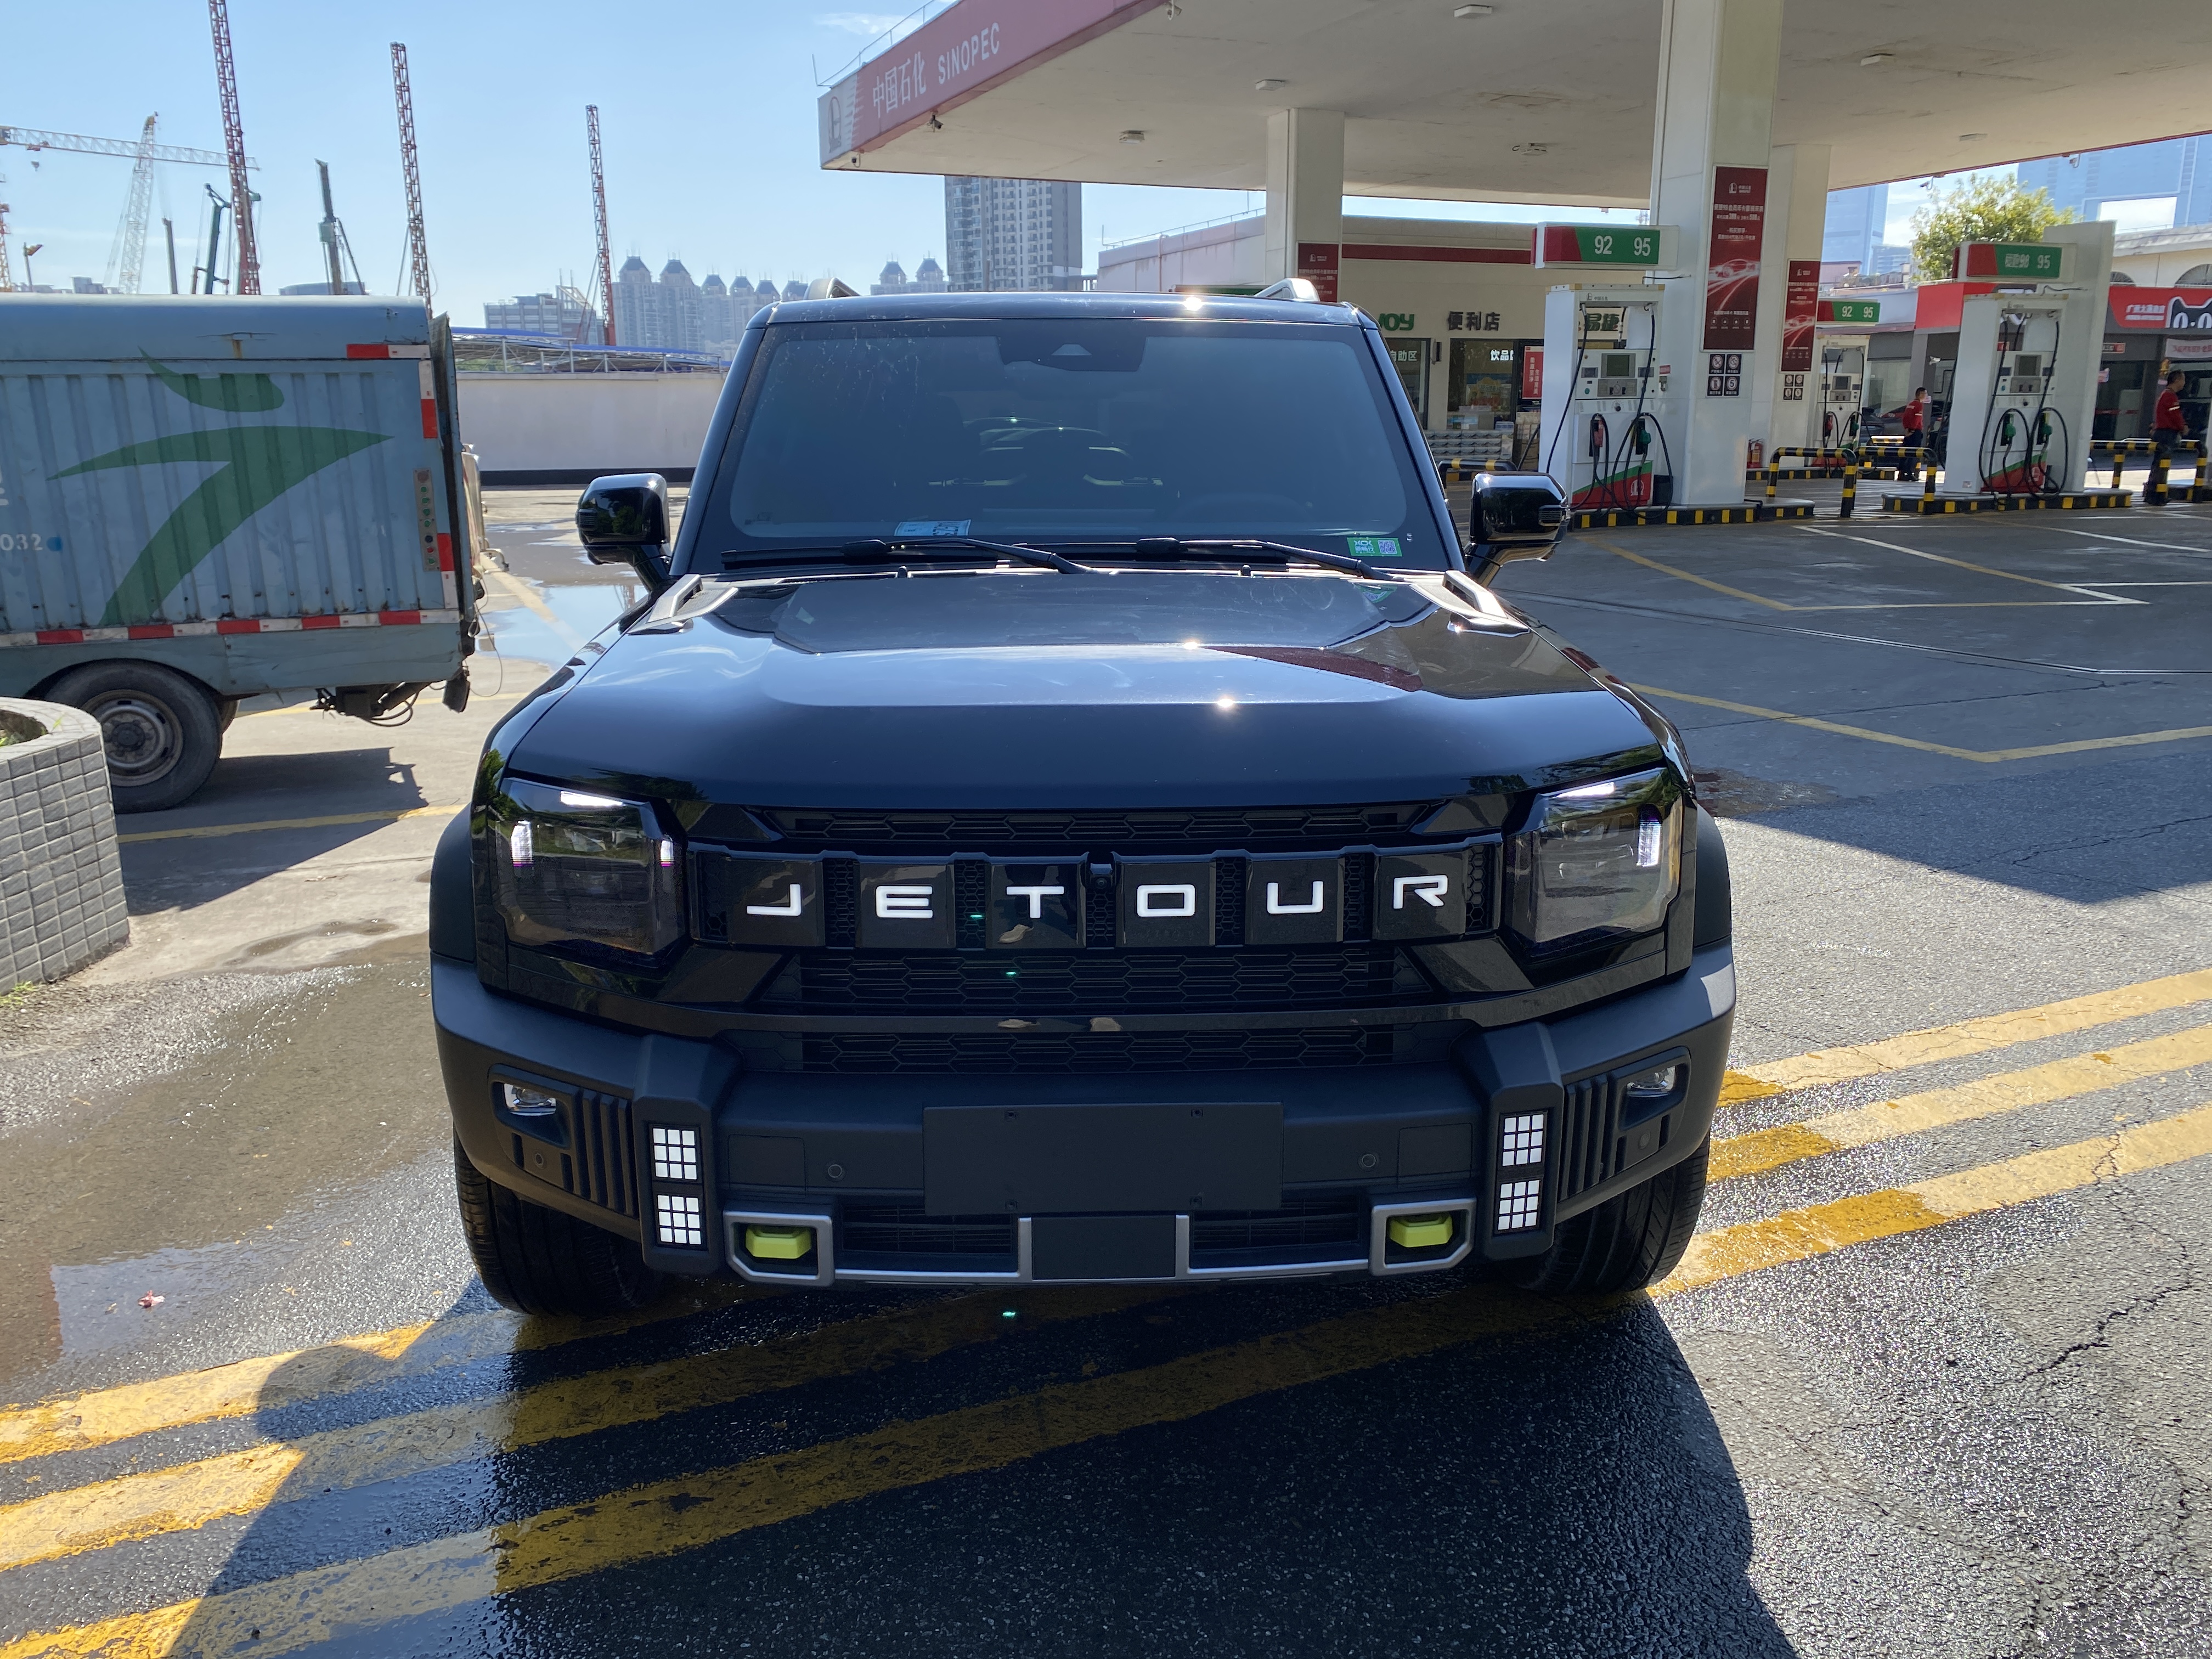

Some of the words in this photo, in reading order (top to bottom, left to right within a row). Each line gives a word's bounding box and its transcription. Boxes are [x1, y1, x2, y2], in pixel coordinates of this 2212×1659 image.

[873, 51, 927, 119] 中国石化
[938, 22, 1000, 84] SINOPEC
[1594, 235, 1613, 255] 92
[1634, 237, 1651, 256] 95
[2037, 255, 2051, 269] 95
[1448, 311, 1500, 331] 便利店
[1842, 306, 1853, 318] 92
[1863, 306, 1874, 318] 95
[1390, 350, 1417, 362] 自助区
[747, 874, 1448, 918] JETOUR
